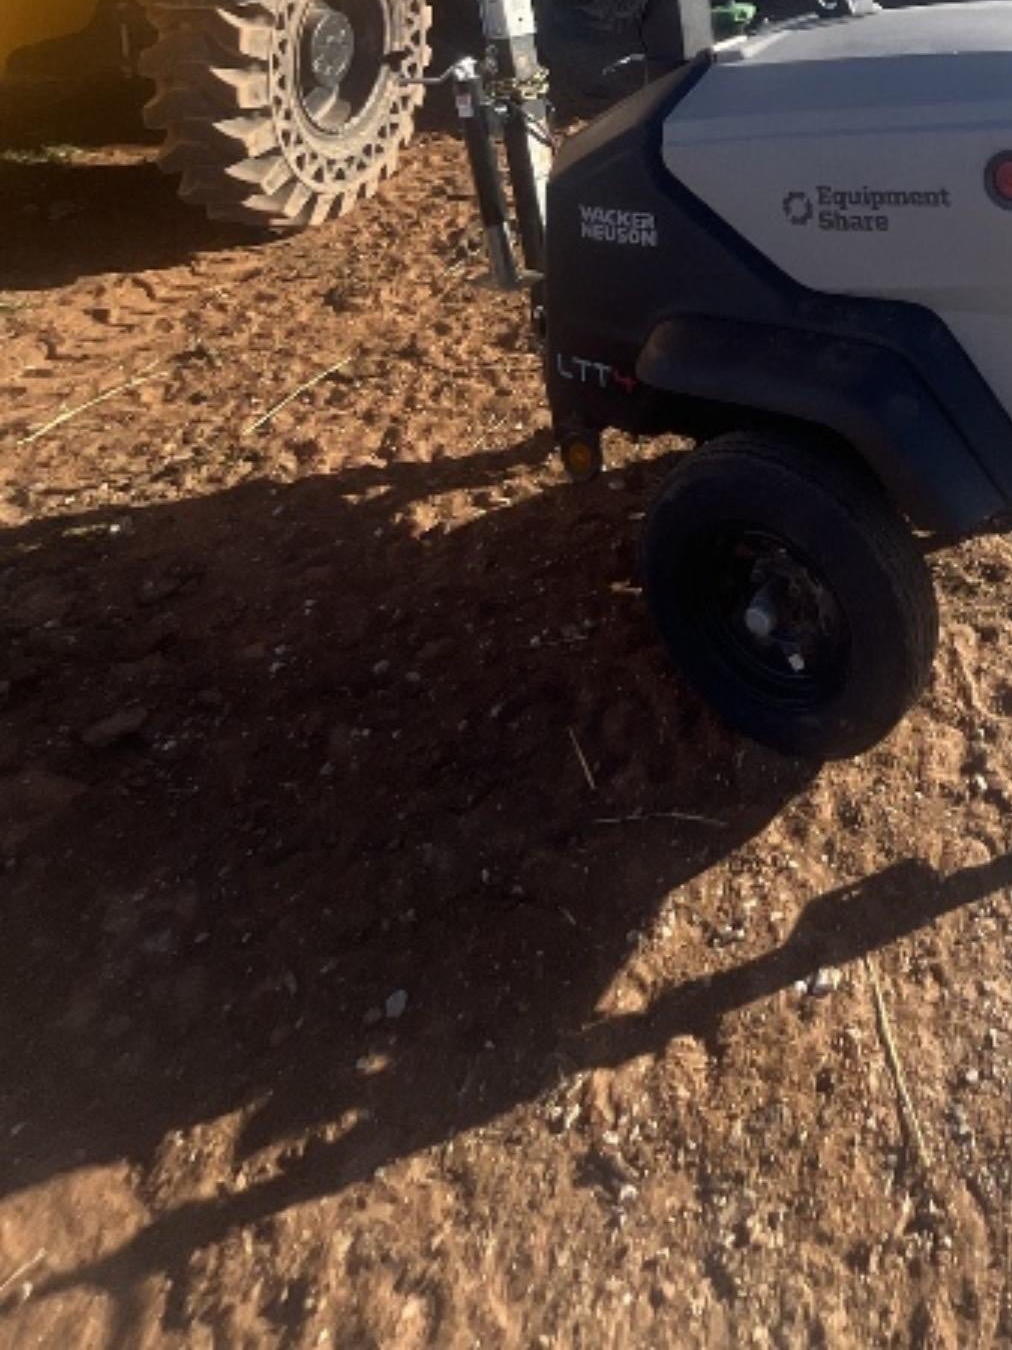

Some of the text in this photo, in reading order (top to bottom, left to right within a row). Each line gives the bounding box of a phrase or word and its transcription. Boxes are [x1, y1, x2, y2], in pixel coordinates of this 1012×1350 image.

[816, 185, 952, 211] Equipment
[579, 204, 655, 229] WACKER
[818, 210, 889, 232] Share
[580, 221, 658, 247] NEUSON
